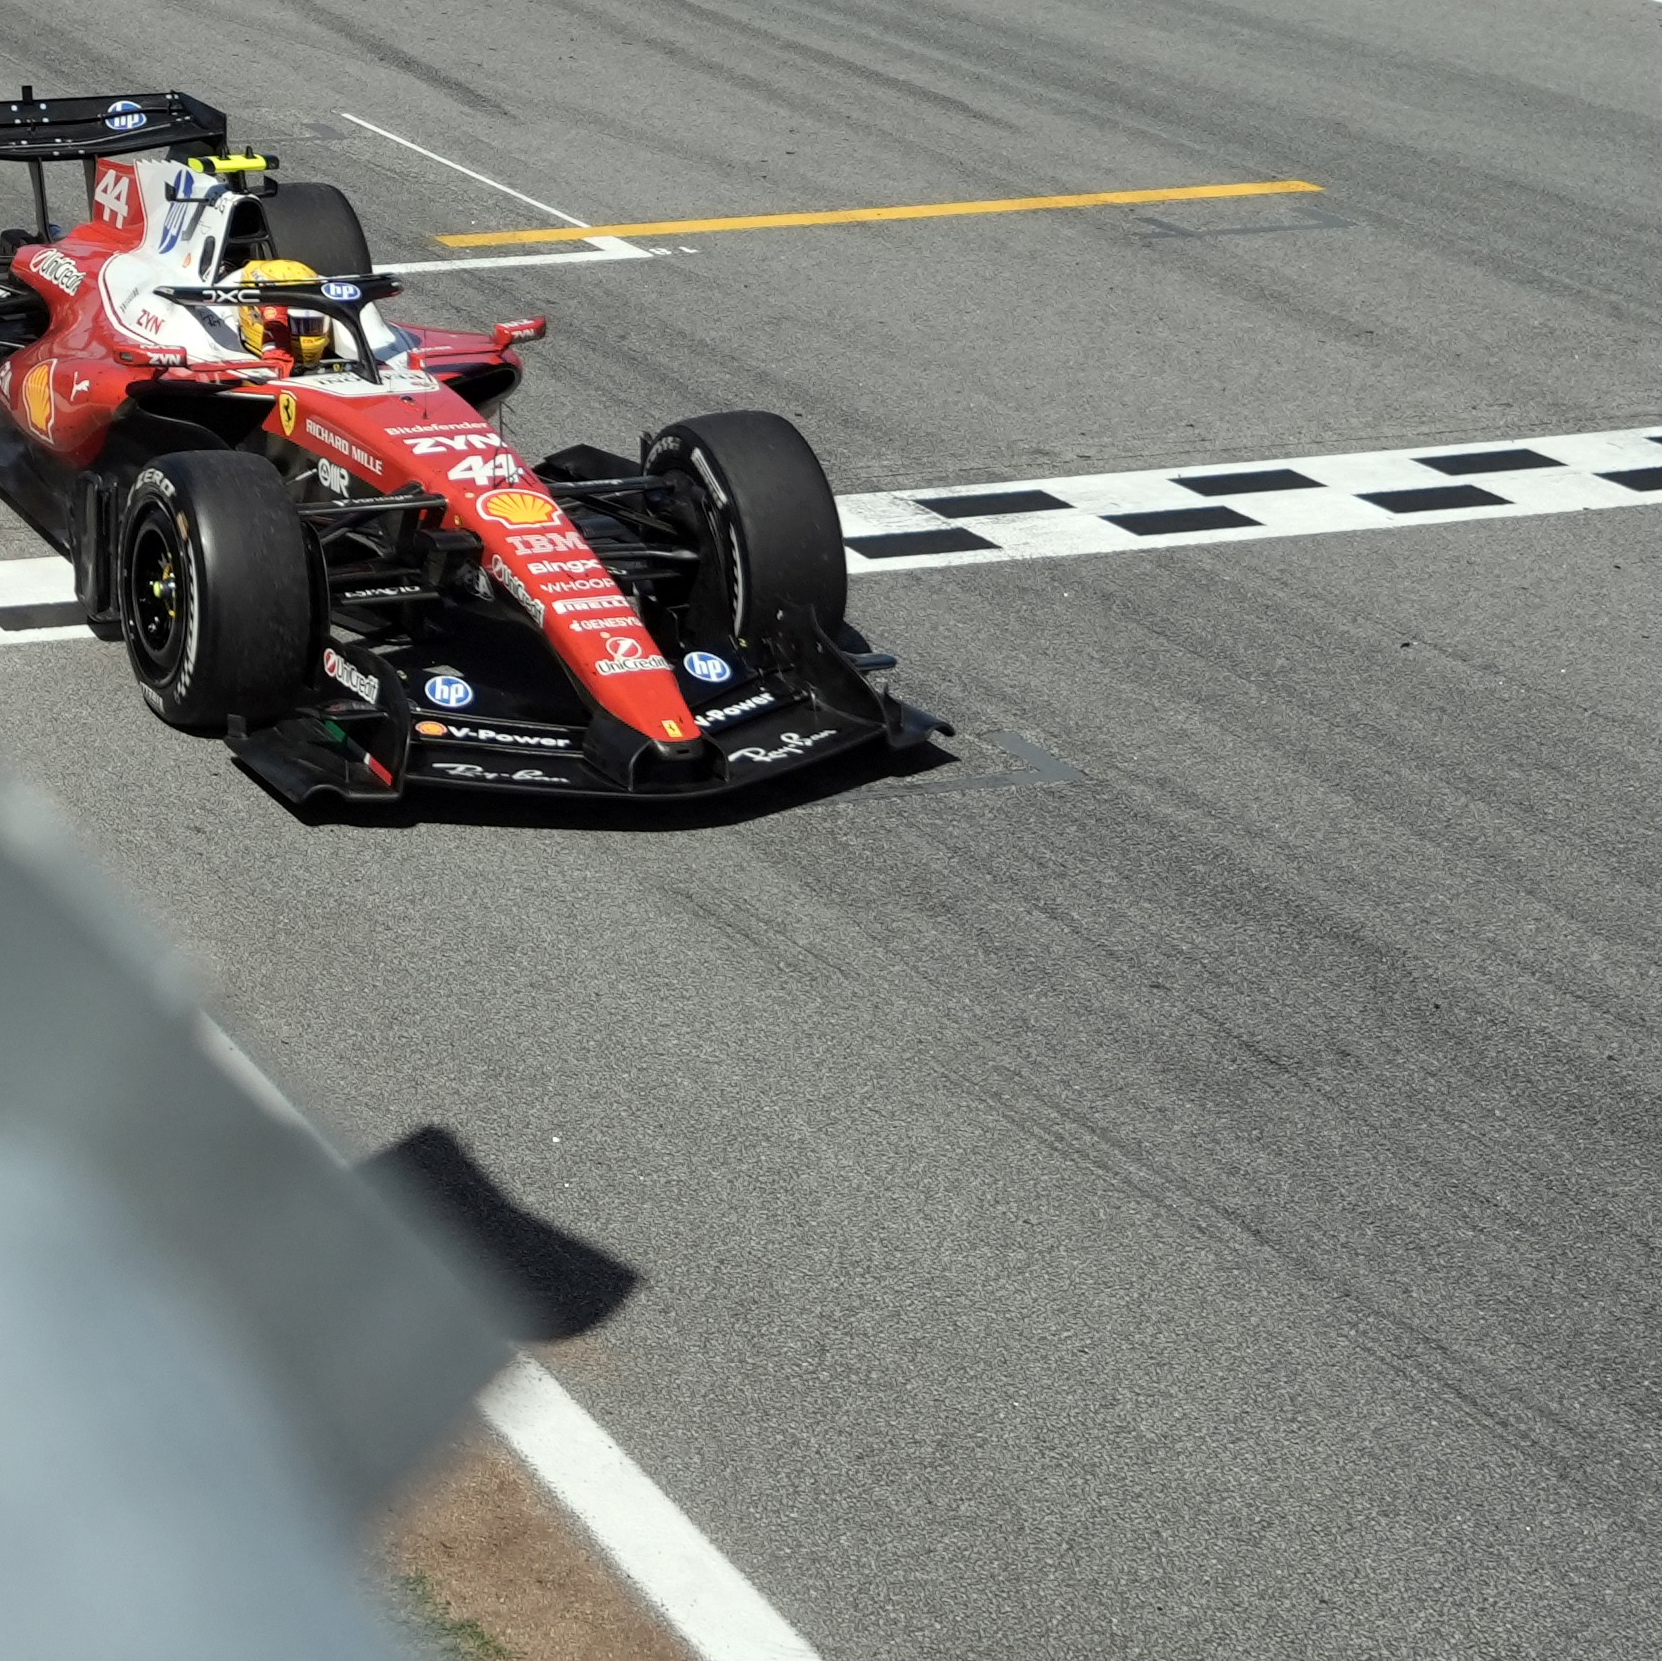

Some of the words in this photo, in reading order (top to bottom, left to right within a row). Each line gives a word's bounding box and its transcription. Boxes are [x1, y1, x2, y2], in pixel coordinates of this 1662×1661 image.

[94, 168, 131, 230] 44
[41, 248, 87, 297] UniCredit
[136, 308, 166, 336] ZYN
[384, 421, 489, 436] Bitdefender
[305, 417, 349, 456] RICHARD
[351, 441, 384, 476] MILLE
[402, 432, 509, 456] ZYN
[447, 453, 523, 486] 44
[505, 531, 590, 556] IBM
[540, 577, 616, 594] WHOOP
[552, 595, 630, 615] PIRELLI
[335, 653, 380, 705] UniCredit
[598, 654, 671, 675] UniCredit
[689, 652, 724, 682] hp
[434, 676, 466, 707] hp
[694, 691, 776, 728] V-Power
[447, 725, 571, 747] V-Power
[727, 728, 838, 763] Ray-Ban
[432, 762, 571, 784] Ray-Ban
